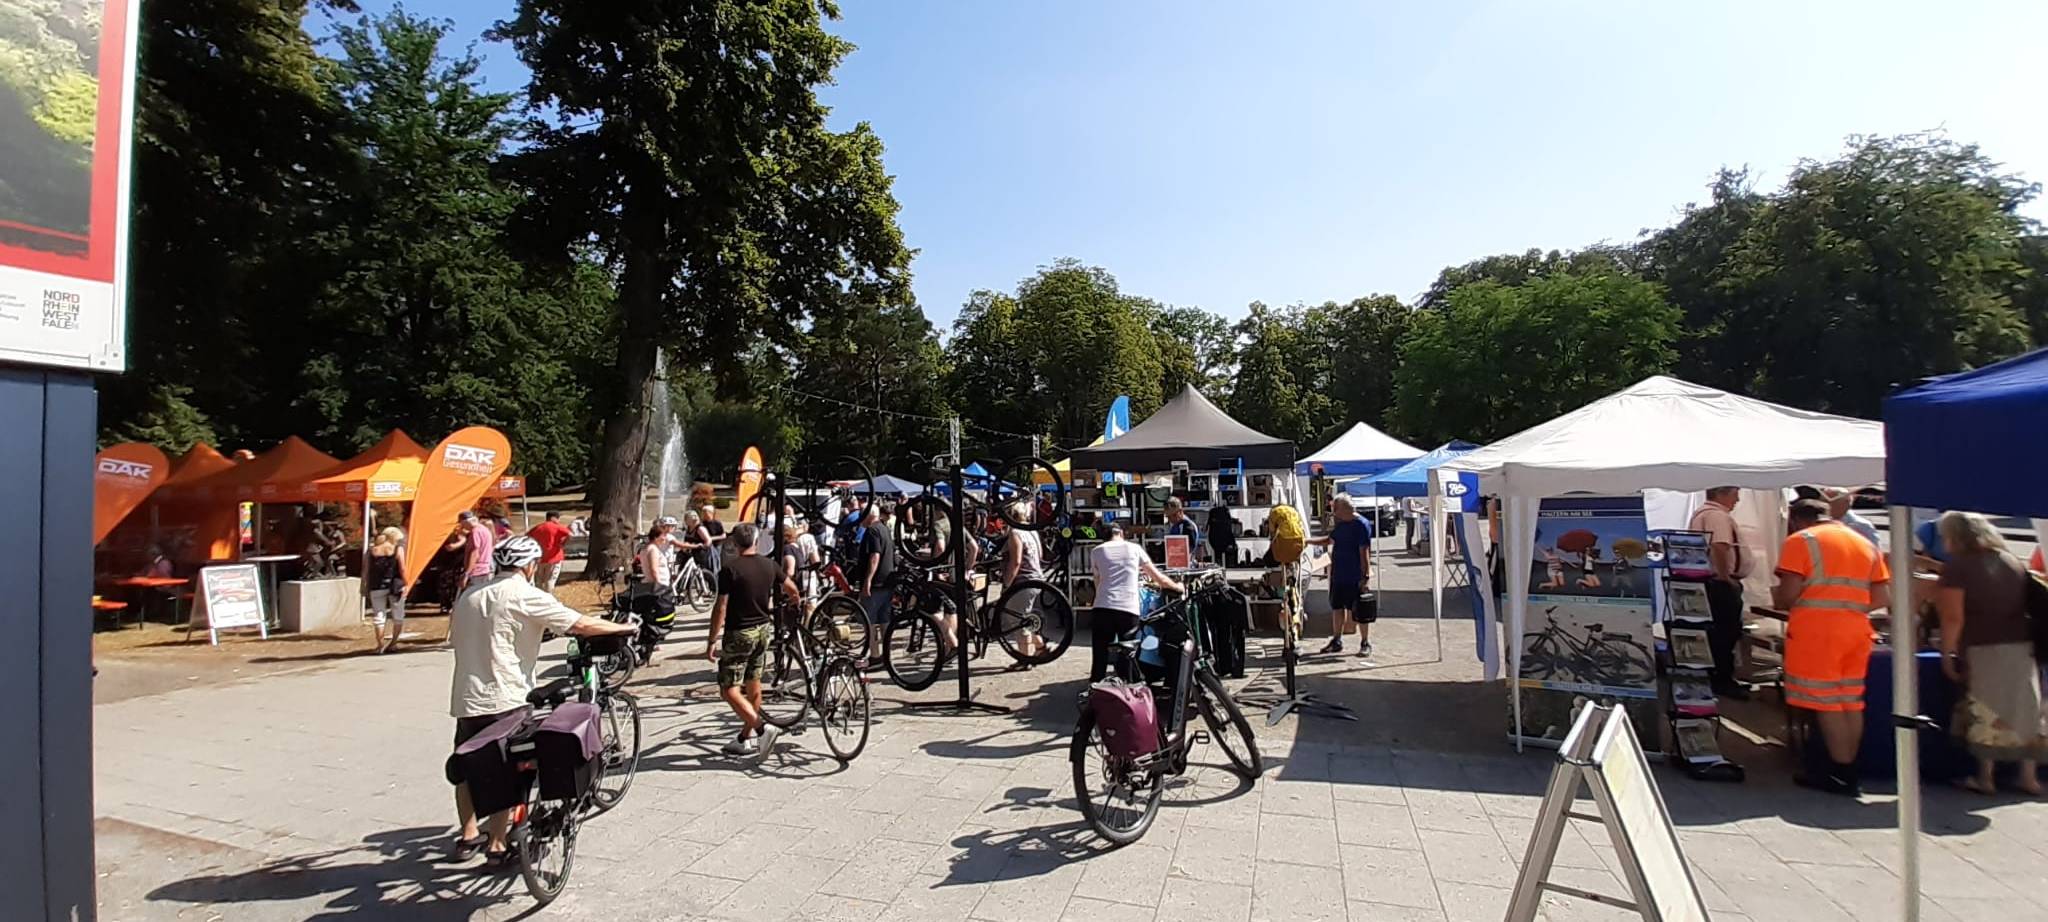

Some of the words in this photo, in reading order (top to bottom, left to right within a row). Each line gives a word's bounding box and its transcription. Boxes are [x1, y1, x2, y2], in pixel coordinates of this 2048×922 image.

[44, 289, 80, 303] NORD
[43, 300, 80, 312] RHEIN
[43, 309, 79, 321] WEST
[444, 446, 496, 465] DAK
[98, 460, 152, 479] DAK
